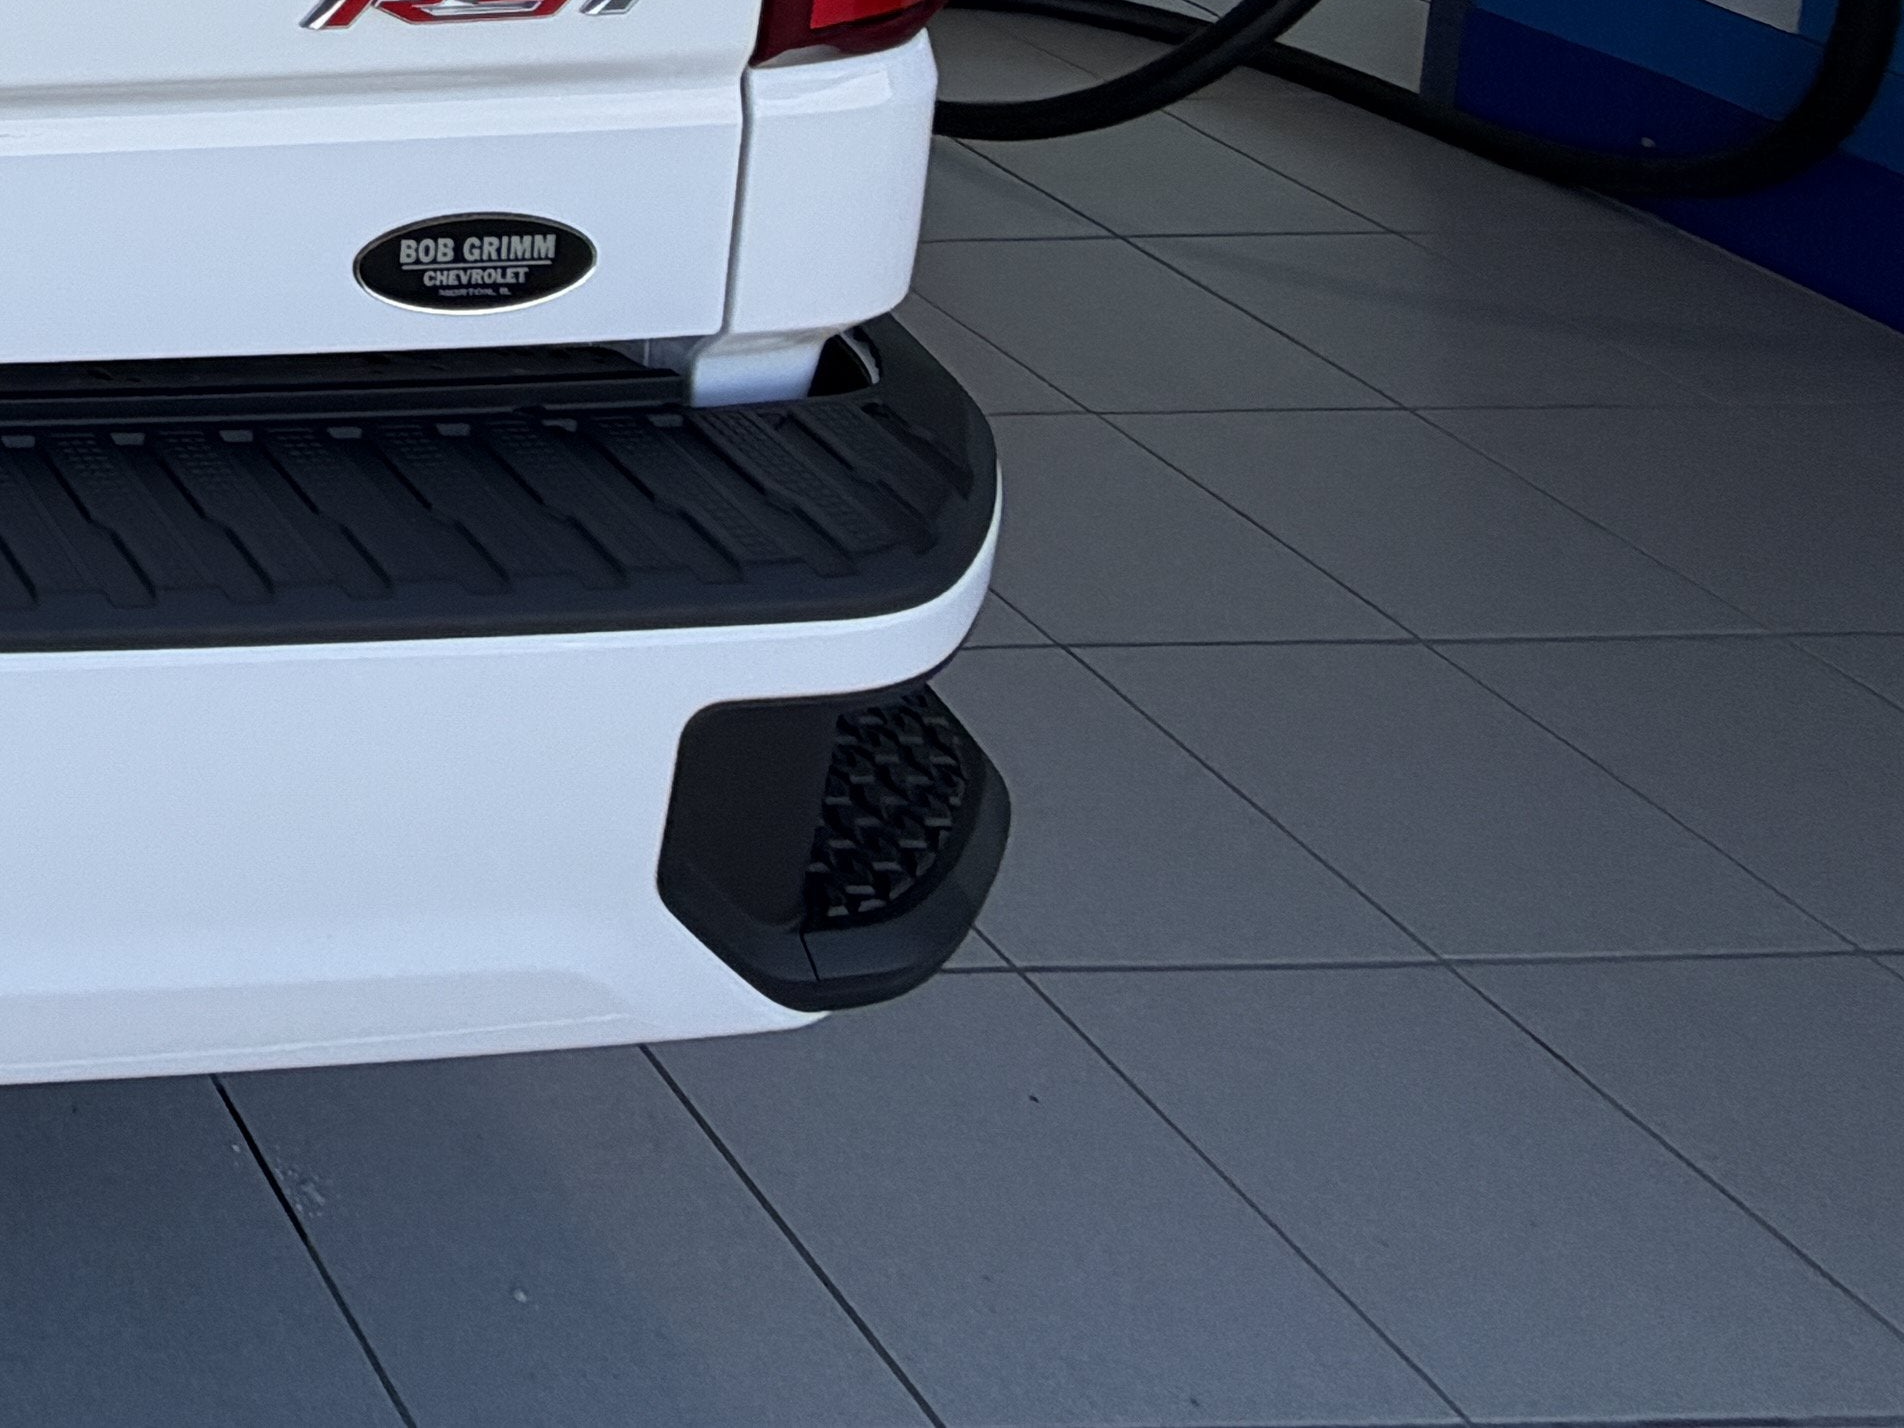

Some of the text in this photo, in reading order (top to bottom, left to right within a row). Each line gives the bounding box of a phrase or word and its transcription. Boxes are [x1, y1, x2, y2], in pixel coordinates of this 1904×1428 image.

[399, 233, 557, 264] BOB GRIMM
[422, 266, 529, 287] CHEVROLET
